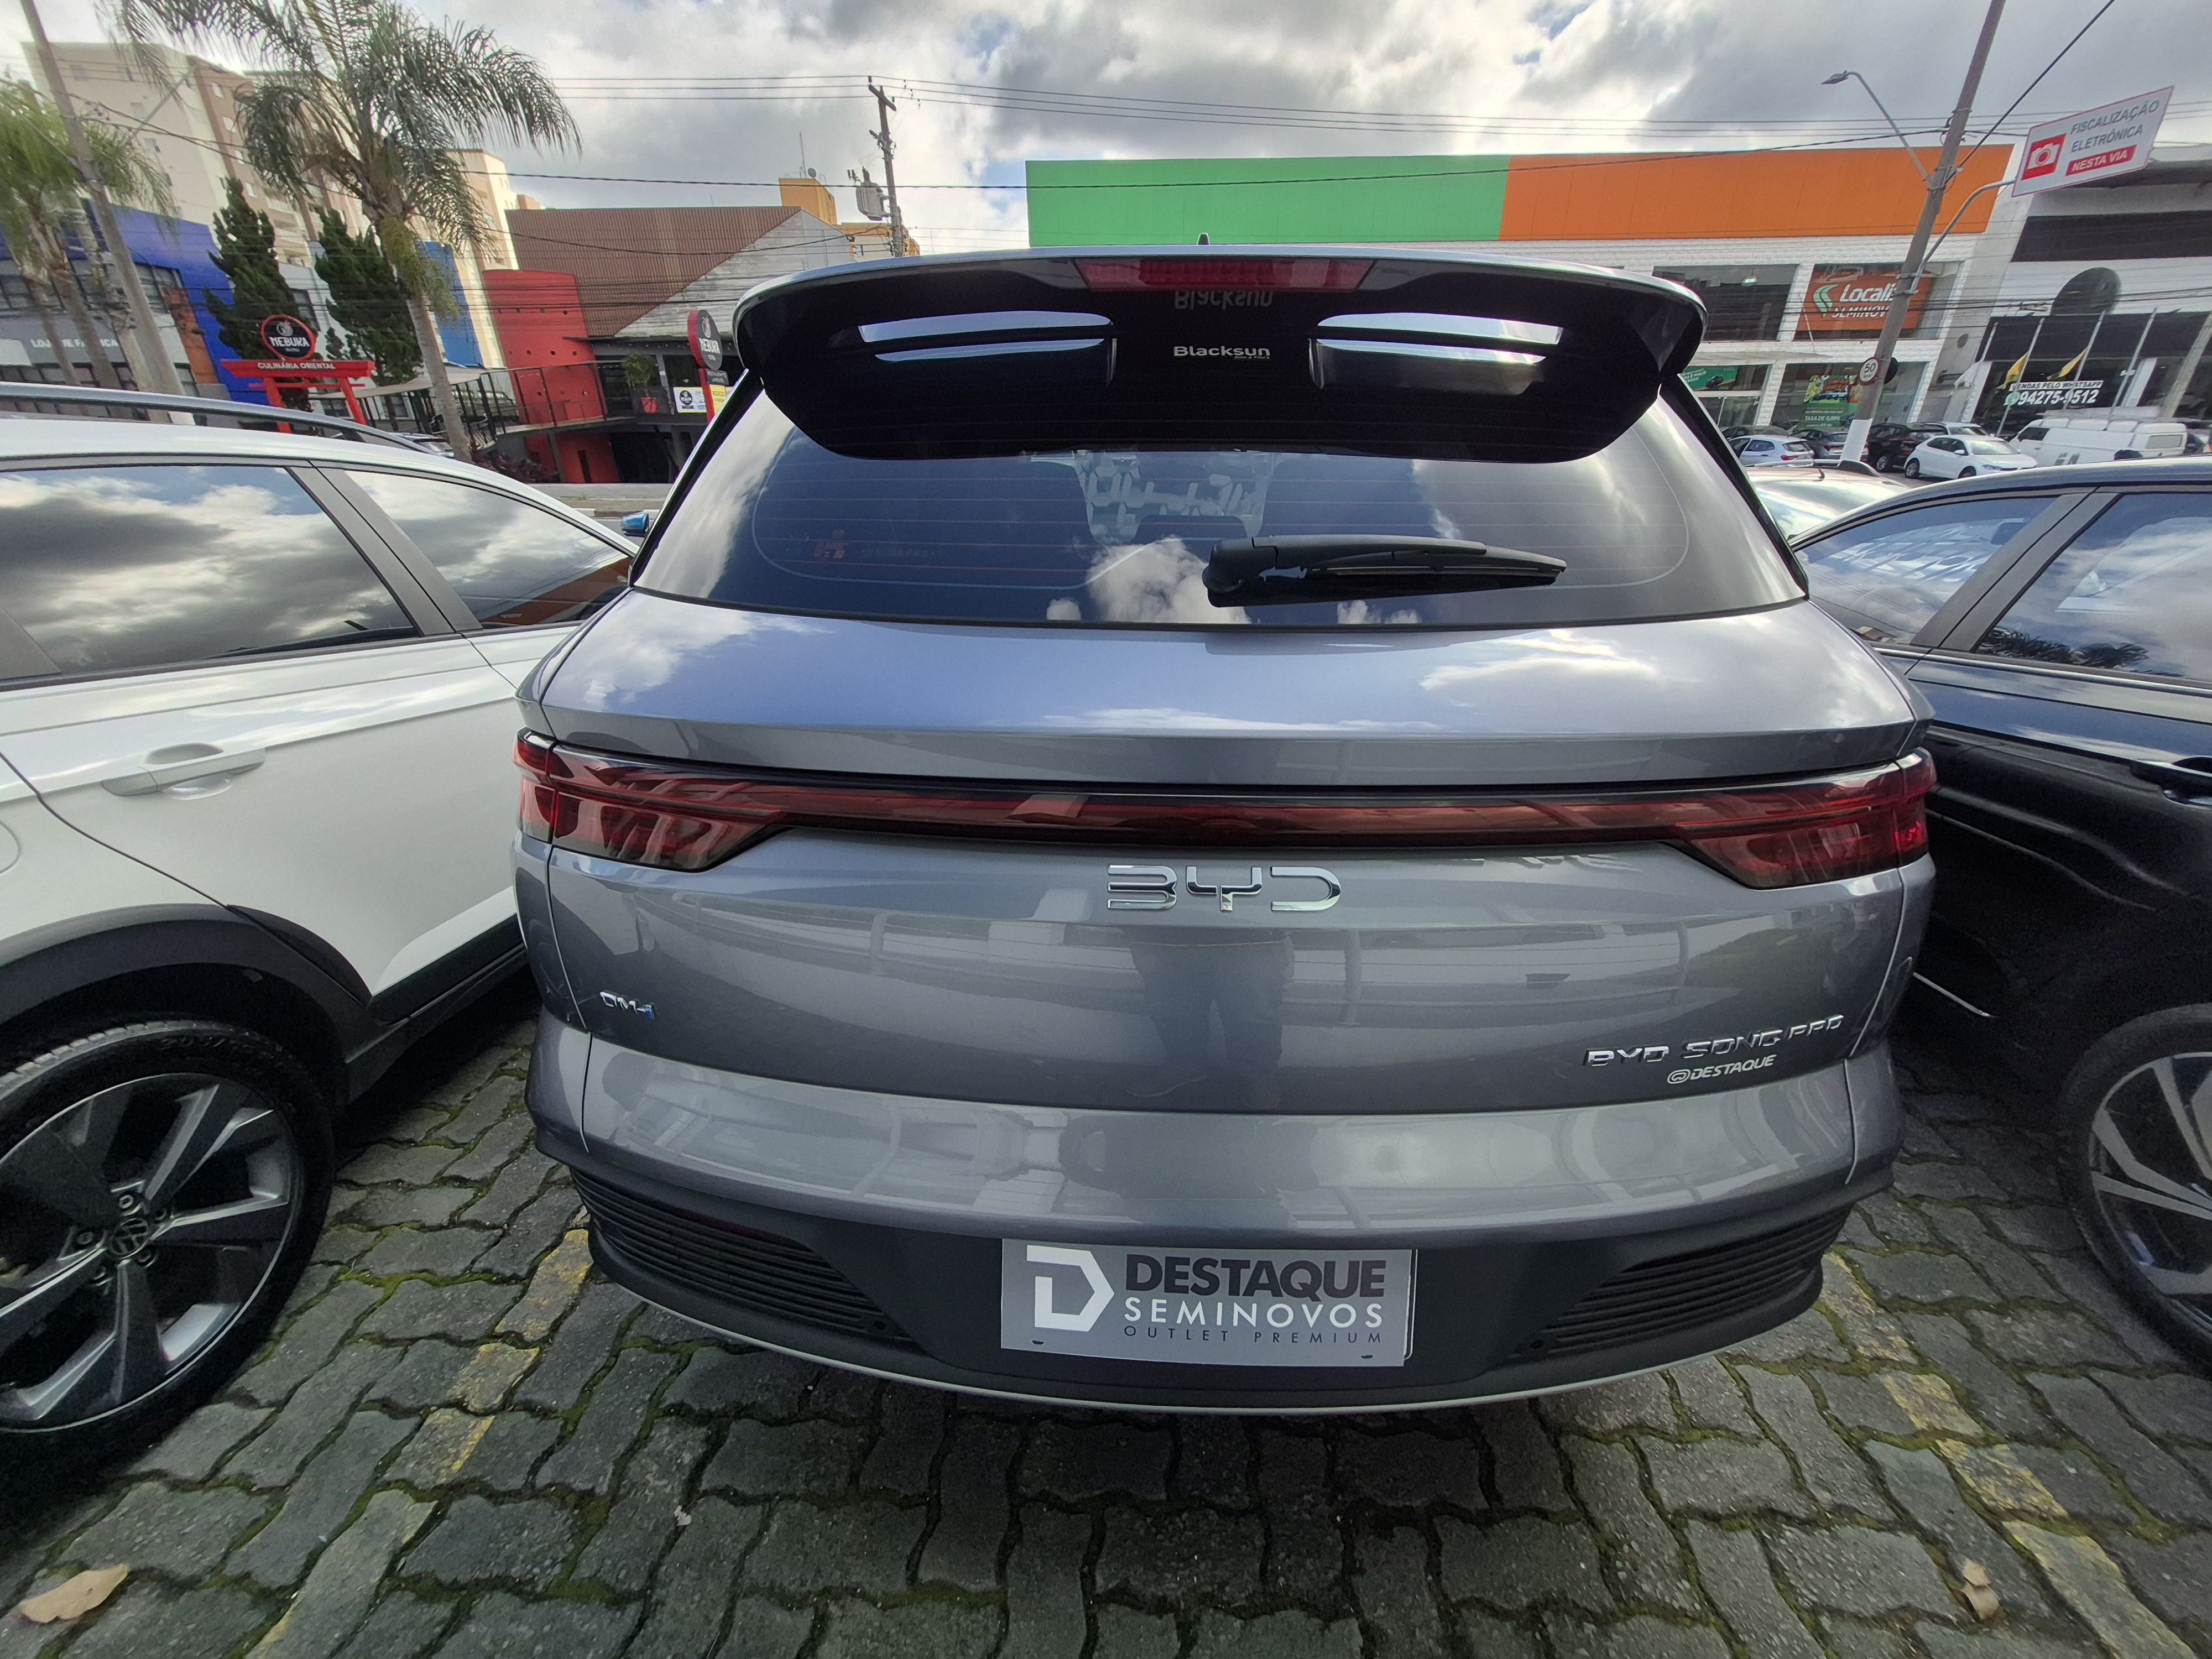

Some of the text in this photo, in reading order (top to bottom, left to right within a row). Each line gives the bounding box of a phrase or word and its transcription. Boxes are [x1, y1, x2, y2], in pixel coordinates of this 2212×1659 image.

[2070, 100, 2160, 135] FISCALIZAÇÃO
[2072, 149, 2128, 172] NESTA VIA
[1839, 283, 1897, 302] Locali
[1831, 306, 1890, 318] SEMINOV
[30, 339, 51, 347] LOJ
[269, 337, 310, 347] NEBUKA
[1173, 346, 1271, 356] Blacksun
[1864, 363, 1876, 373] 50
[2017, 389, 2099, 405] 94275-9512
[1108, 864, 1342, 912] BYD
[1587, 1045, 1670, 1067] BYD
[1683, 1029, 1783, 1058] SONG
[1667, 1053, 1777, 1084] @DESTAQUE
[1125, 1253, 1387, 1302] DESTAQUE
[1124, 1296, 1383, 1328] SEMINOVOS
[1124, 1325, 1381, 1344] OUTLET PREMIUM
